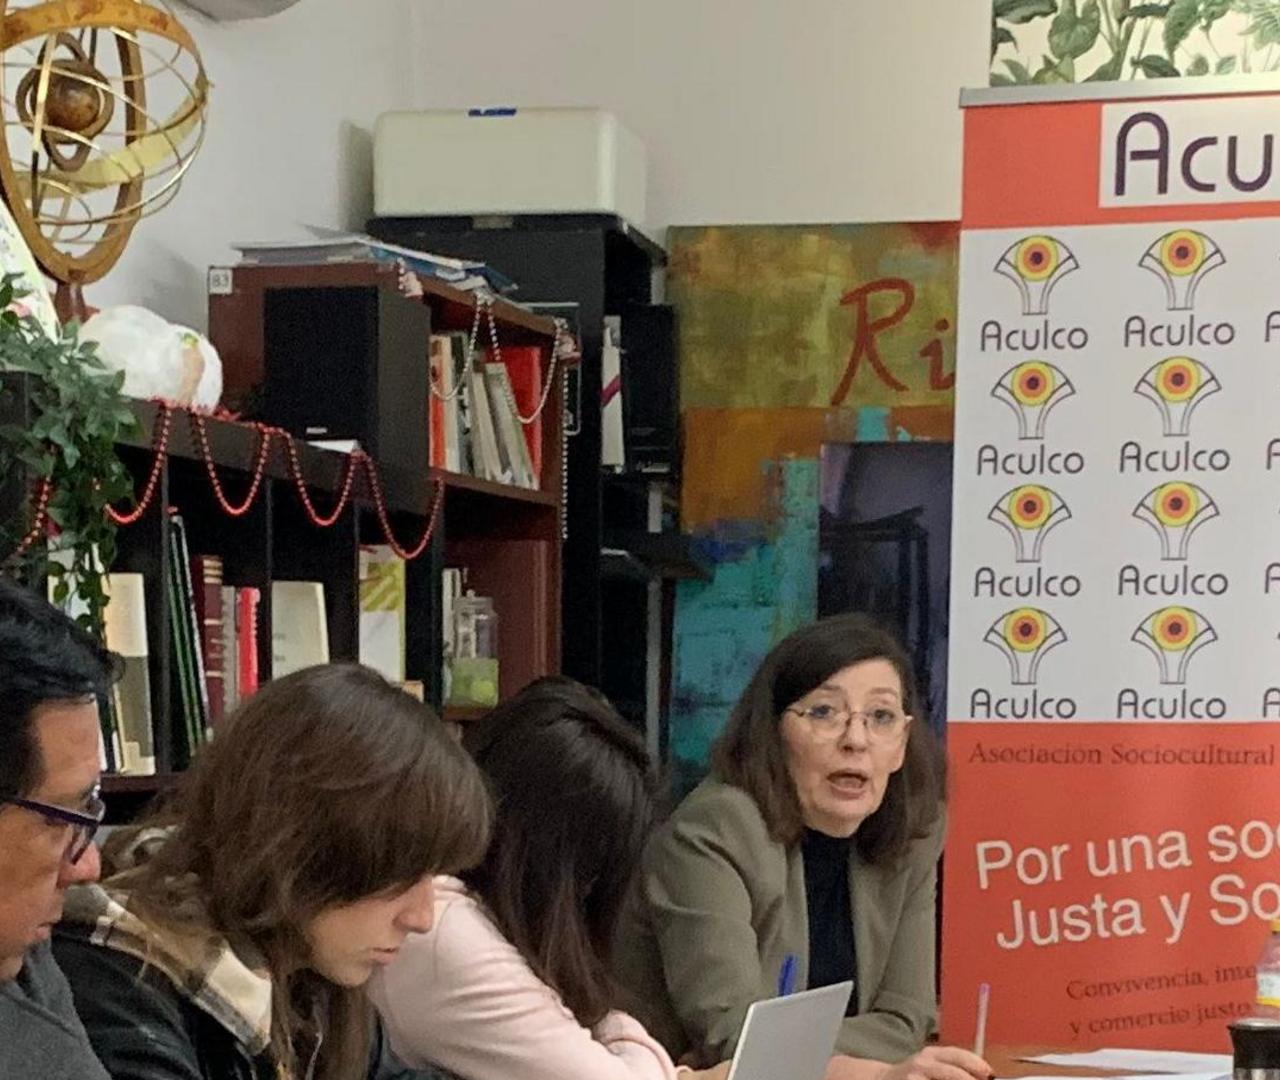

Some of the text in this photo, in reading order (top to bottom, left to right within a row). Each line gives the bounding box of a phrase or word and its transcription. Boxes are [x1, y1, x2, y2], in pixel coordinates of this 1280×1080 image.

[981, 320, 1088, 351] Aculco
[1124, 315, 1235, 347] Aculco
[977, 444, 1084, 475] Aculco
[1120, 441, 1230, 472] Aculco
[974, 567, 1081, 597] Aculco
[1118, 565, 1228, 595] Aculco
[970, 688, 1077, 719] Aculco
[1117, 688, 1226, 719] Aculco
[1111, 743, 1275, 767] Sociocultural
[976, 840, 1070, 890] Por
[1086, 830, 1193, 877] una
[996, 893, 1147, 949] Justa
[1159, 892, 1191, 944] y
[1069, 1022, 1081, 1041] y
[1088, 1010, 1190, 1035] comercio
